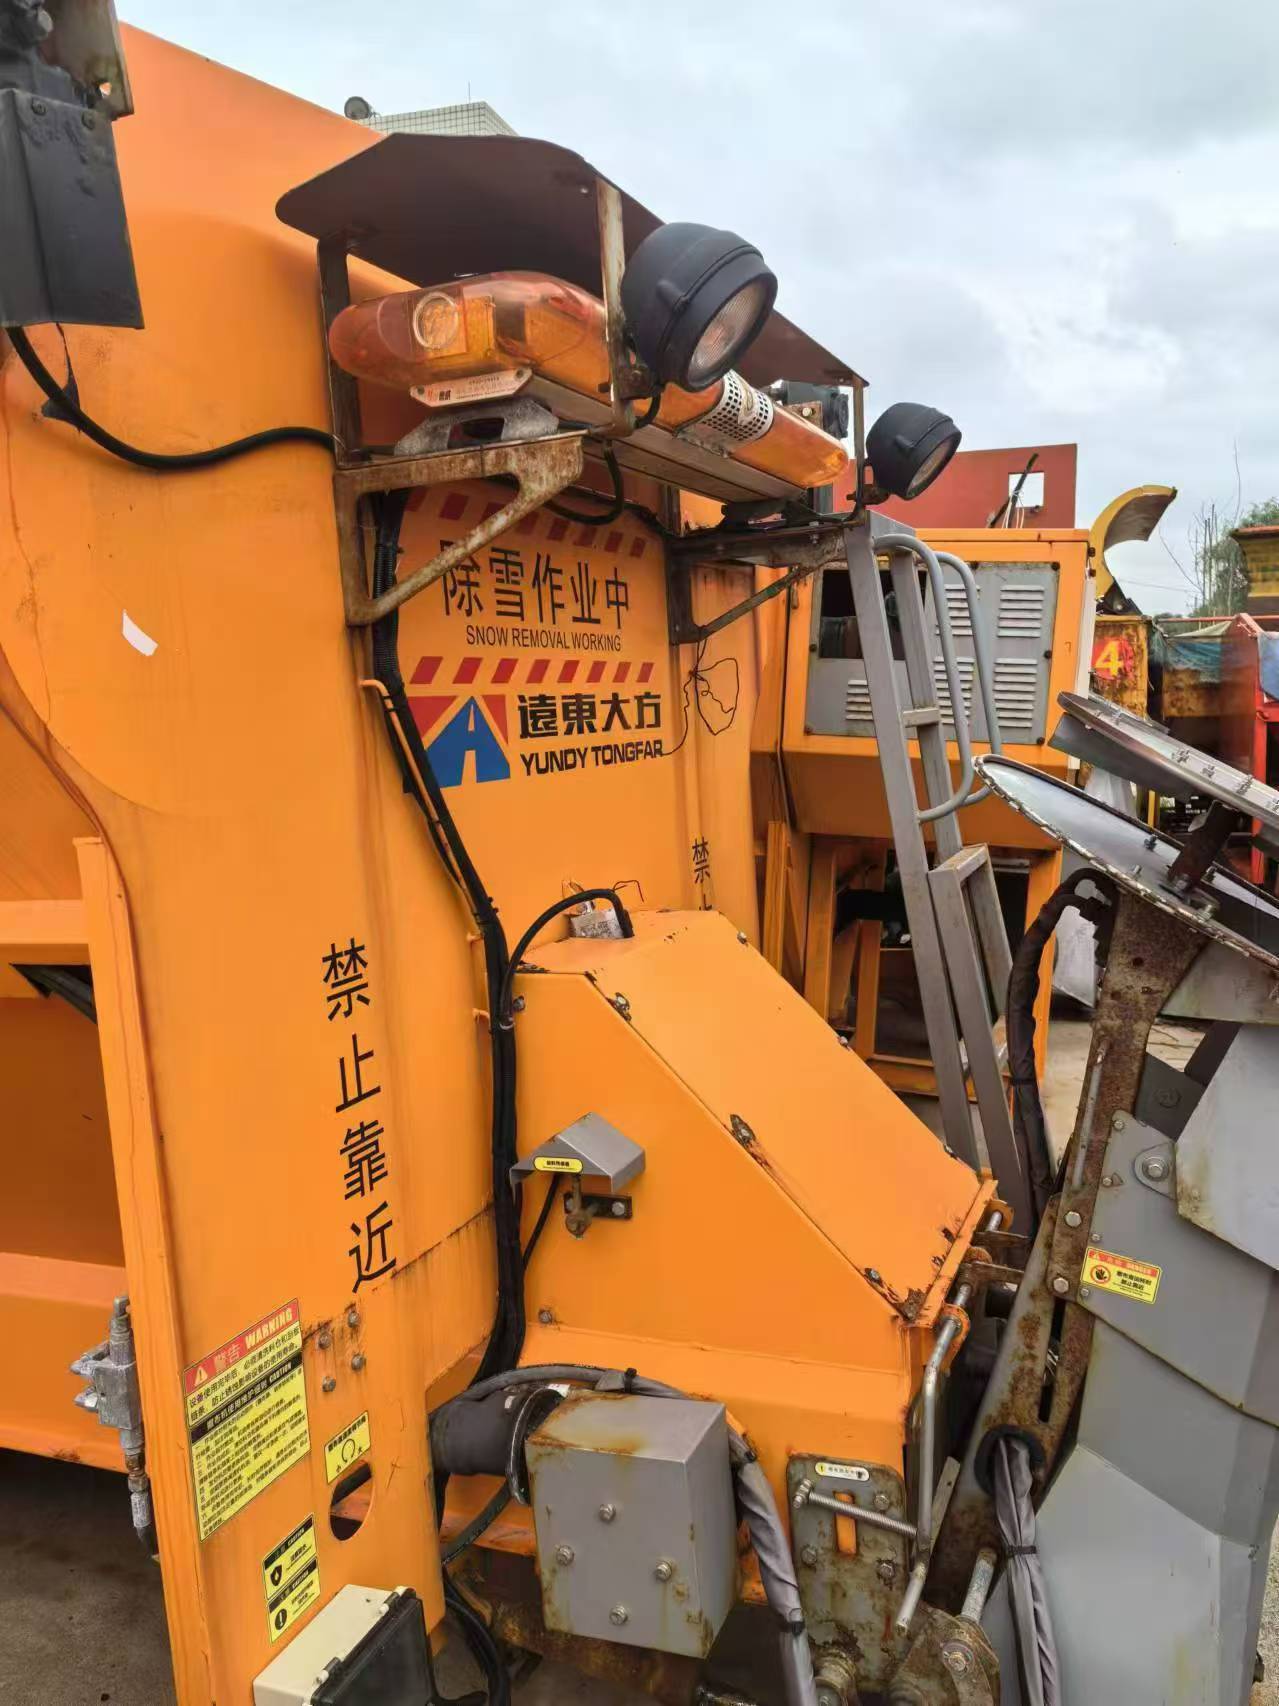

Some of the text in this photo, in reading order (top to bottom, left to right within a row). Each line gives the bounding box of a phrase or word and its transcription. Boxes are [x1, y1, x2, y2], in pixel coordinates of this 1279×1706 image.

[440, 540, 629, 629] 除雪作业中
[466, 624, 621, 652] SNOW REMOVAL WORKING
[1095, 640, 1124, 677] 4
[517, 692, 662, 739] 遠東大方
[591, 739, 663, 766] TONGFAR
[322, 937, 397, 1294] 禁止靠近
[244, 1307, 293, 1350] WARNING
